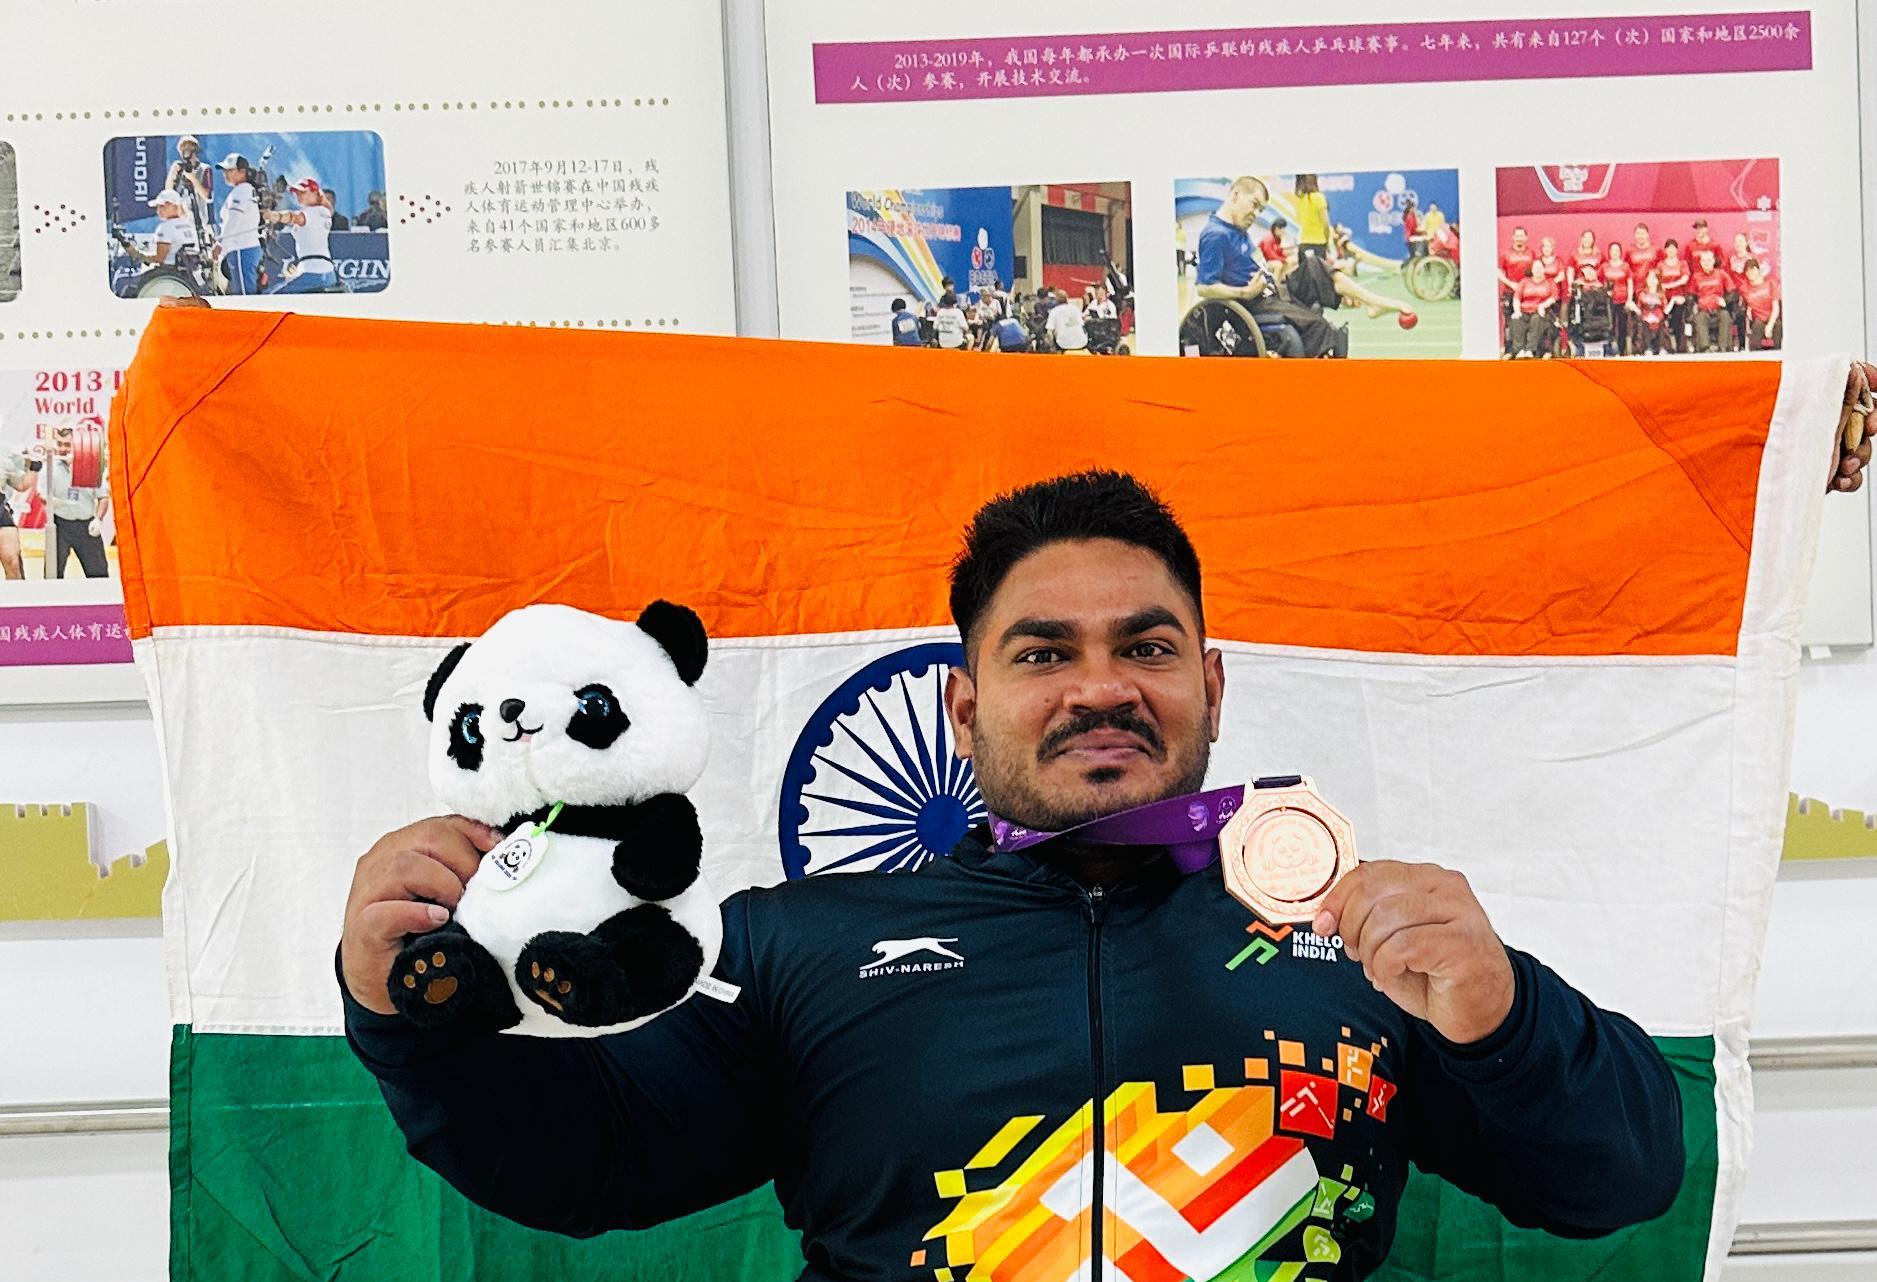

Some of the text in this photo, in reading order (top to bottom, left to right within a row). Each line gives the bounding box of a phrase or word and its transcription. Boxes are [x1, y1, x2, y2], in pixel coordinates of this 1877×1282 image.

[36, 370, 102, 392] 2013
[35, 397, 94, 414] World
[1292, 931, 1344, 949] KHELO
[1292, 943, 1338, 962] INDIA
